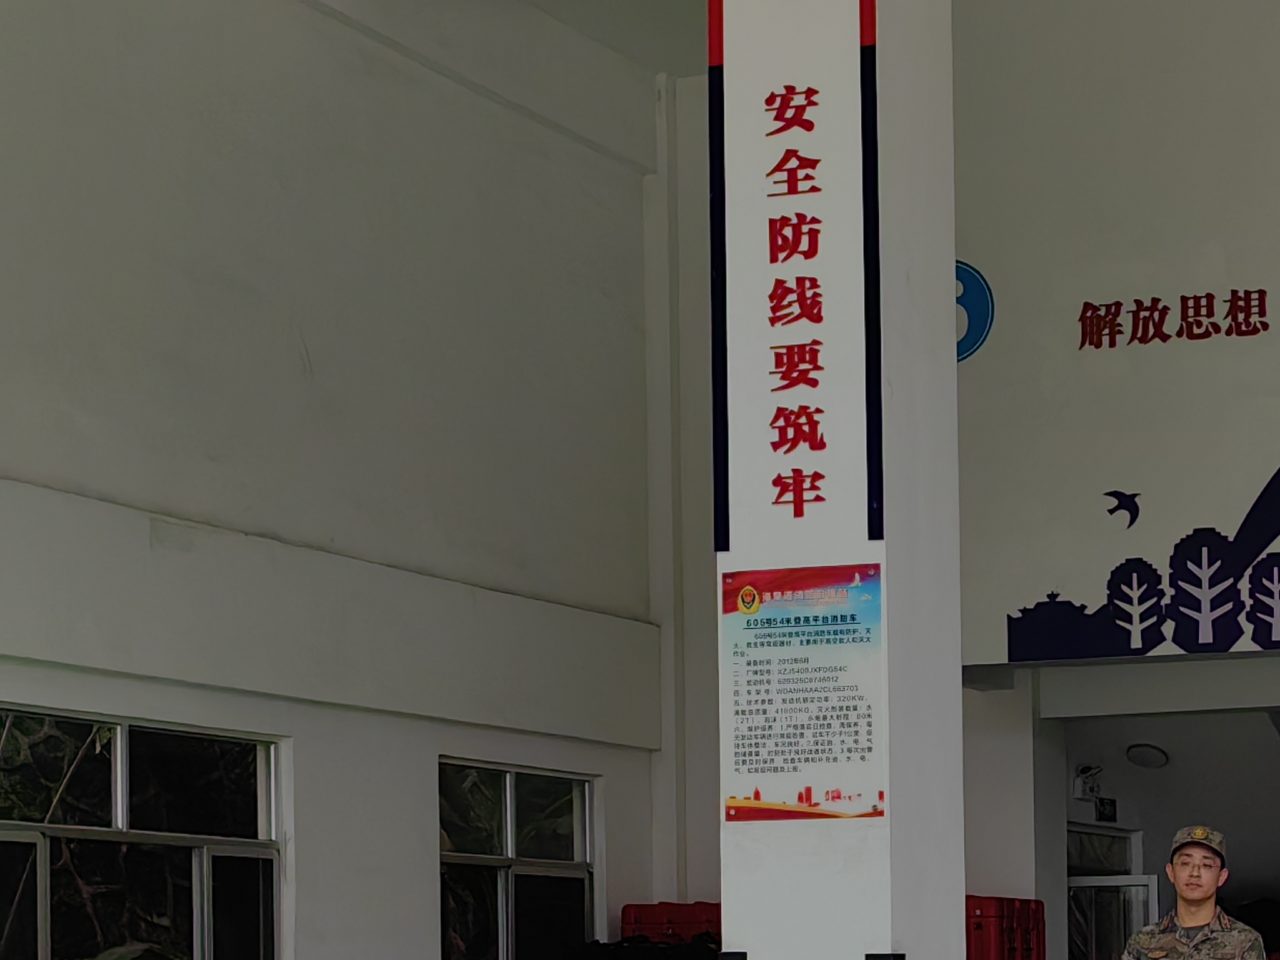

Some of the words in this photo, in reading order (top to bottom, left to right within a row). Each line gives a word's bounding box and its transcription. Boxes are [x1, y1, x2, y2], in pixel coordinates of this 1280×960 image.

[764, 84, 827, 518] 安全防线要筑牢
